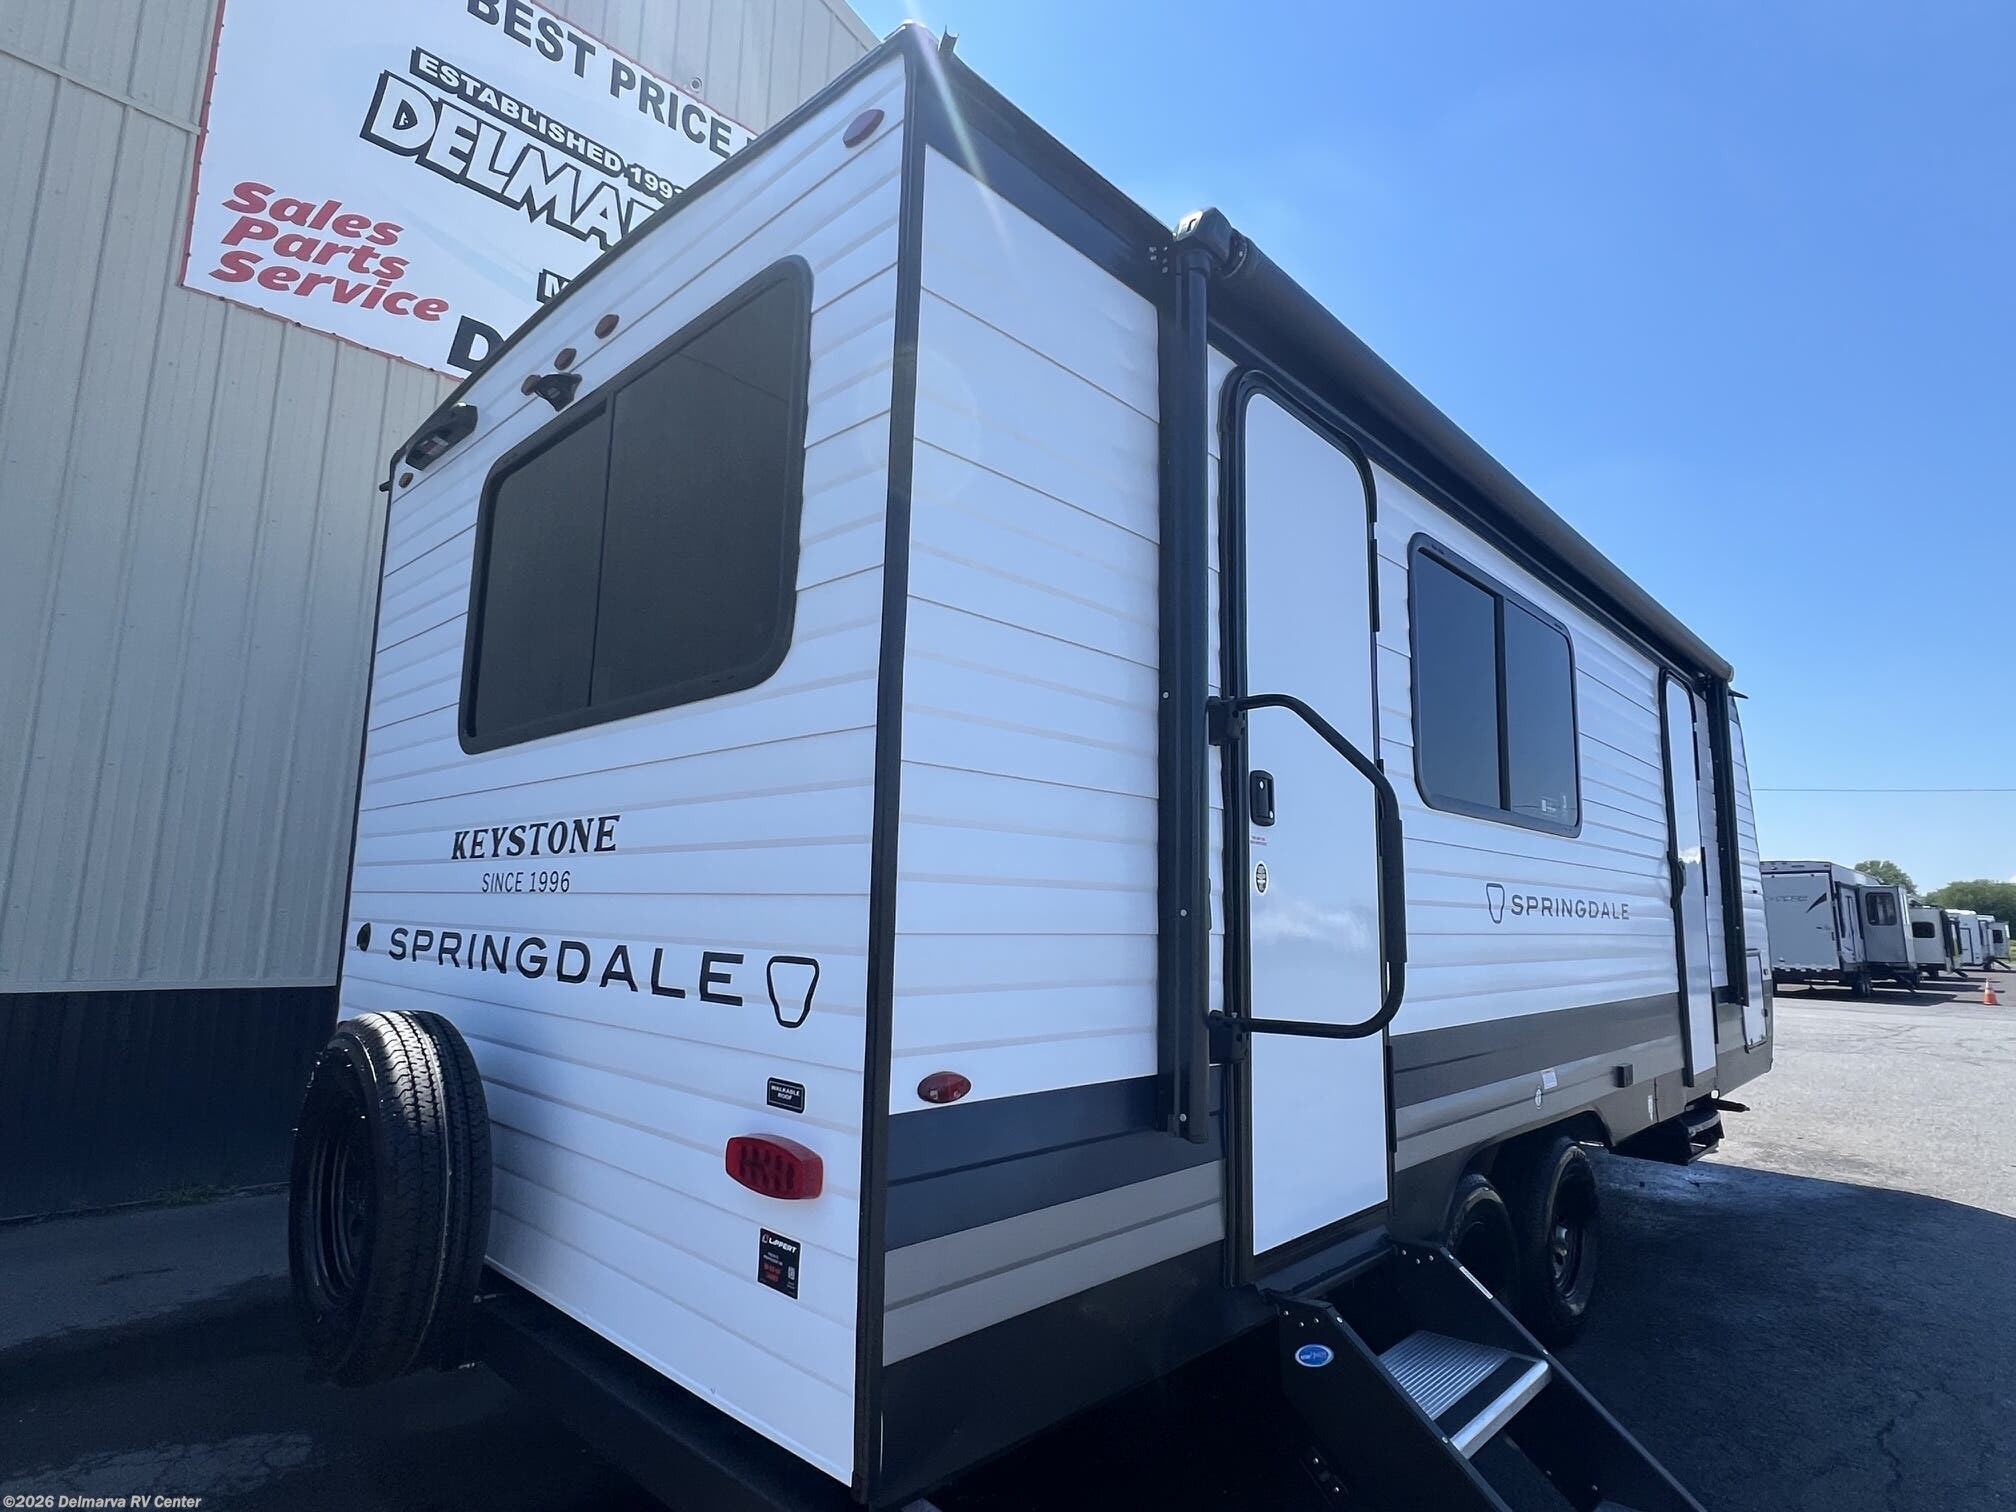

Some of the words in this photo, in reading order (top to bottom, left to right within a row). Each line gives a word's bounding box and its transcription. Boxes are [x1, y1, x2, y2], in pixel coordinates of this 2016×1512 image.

[467, 0, 597, 78] BEST
[610, 58, 732, 159] PRICE
[413, 48, 624, 175] ESTABLISHED
[628, 164, 686, 202] 199
[221, 181, 405, 247] Sales
[219, 216, 409, 280] Parts
[208, 250, 449, 321] Service
[451, 814, 621, 860] KEYSTONE
[481, 871, 523, 893] SINCE
[528, 870, 571, 893] 1996
[1511, 894, 1630, 920] SPRINGDALE
[388, 927, 744, 1007] SPRINGDALE
